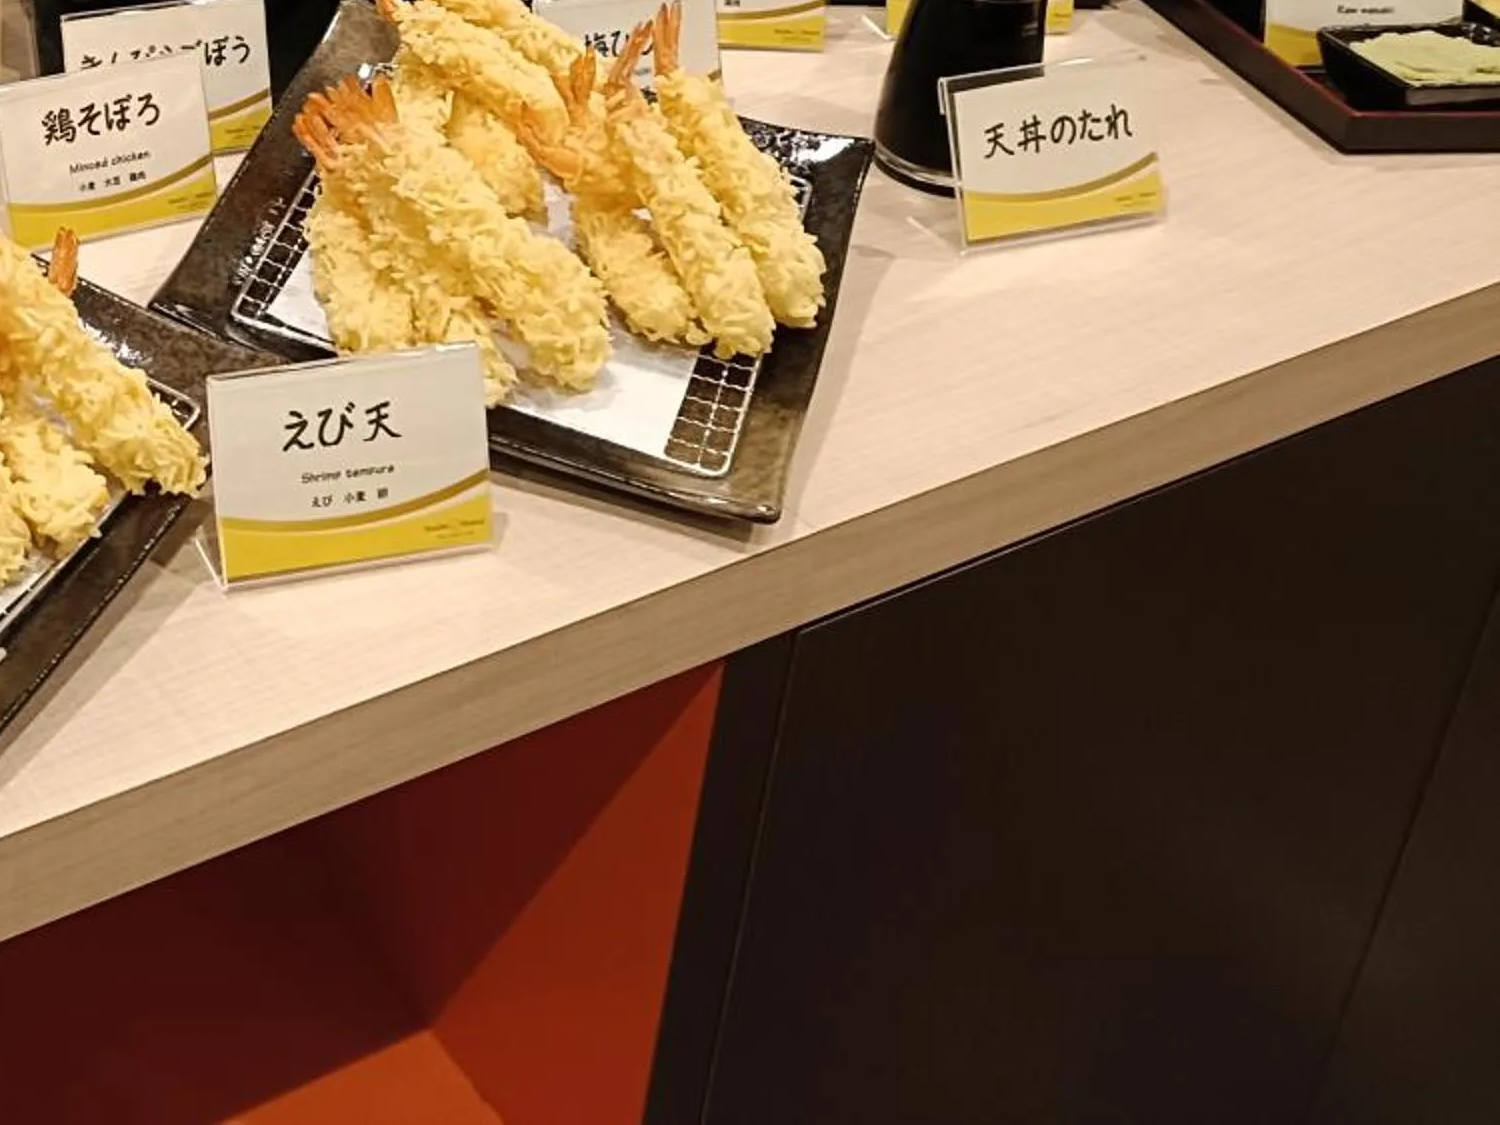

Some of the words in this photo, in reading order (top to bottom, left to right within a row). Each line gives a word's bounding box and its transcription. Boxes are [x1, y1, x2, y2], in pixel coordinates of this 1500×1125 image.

[41, 93, 162, 145] 鶏そぼろ
[983, 103, 1133, 159] 天丼のたれ
[69, 157, 109, 174] Minced
[111, 150, 150, 167] chicken
[282, 400, 403, 452] えび天
[301, 470, 342, 484] Shrimp
[345, 464, 395, 479] tempura
[311, 495, 333, 508] えび
[344, 490, 366, 503] 小麦
